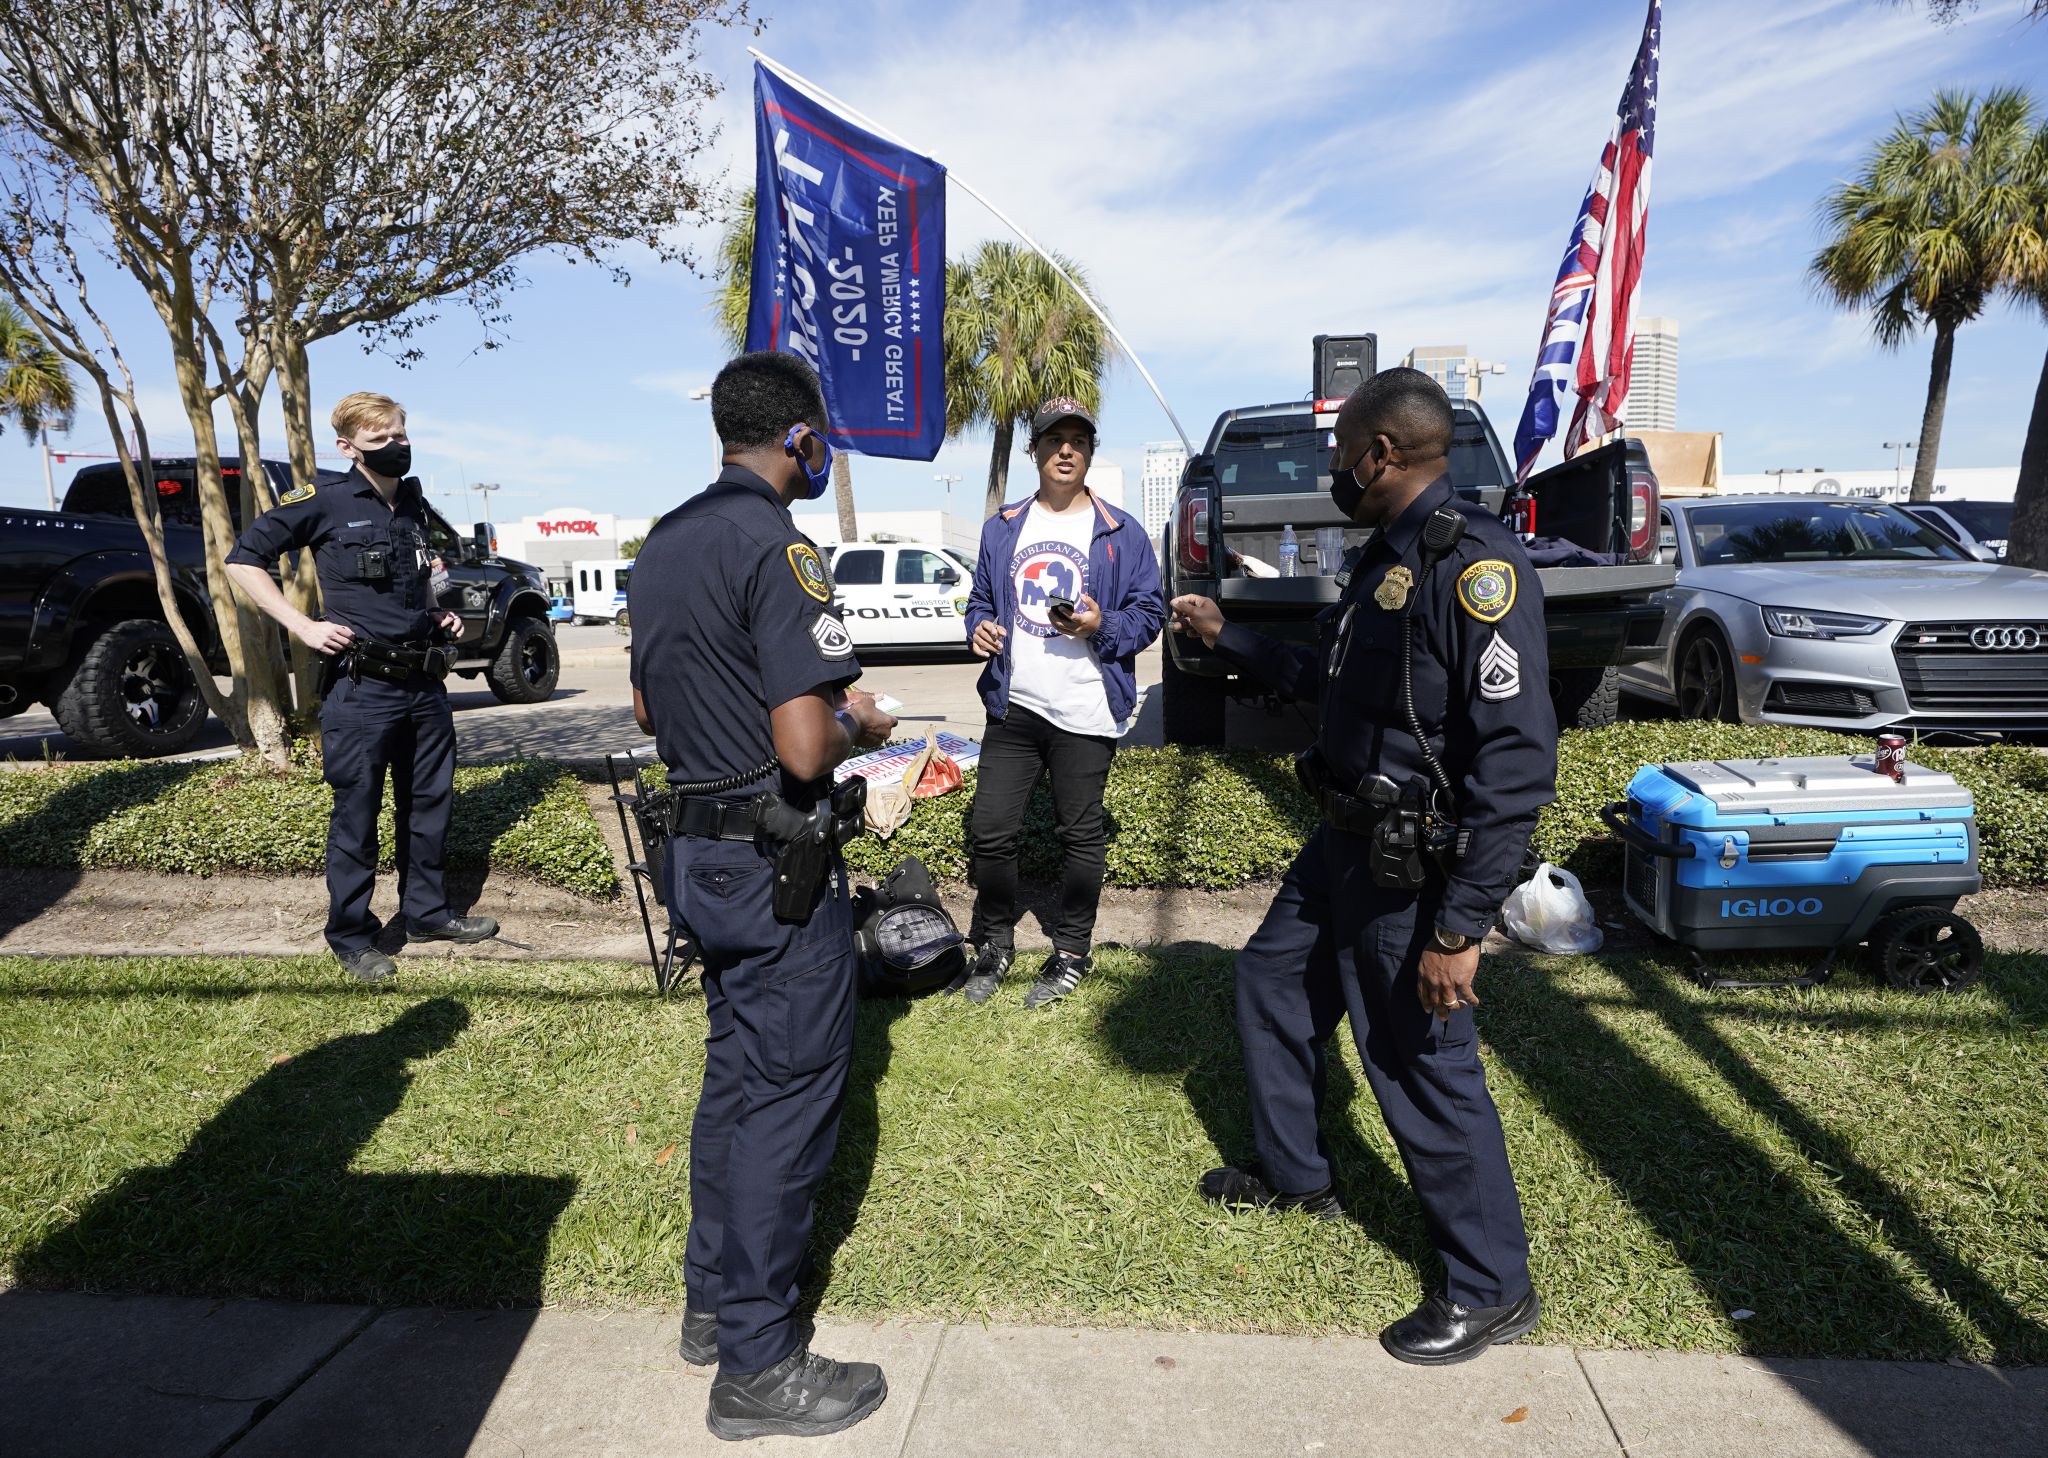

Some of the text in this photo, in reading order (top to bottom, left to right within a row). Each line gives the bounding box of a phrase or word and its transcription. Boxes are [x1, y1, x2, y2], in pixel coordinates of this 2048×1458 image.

[1846, 486, 1909, 497] ATHLETC
[1010, 542, 1072, 578] REPUBLICAN
[1463, 564, 1506, 582] HOUSTON
[1477, 599, 1506, 611] POLICE
[1015, 614, 1028, 628] OF
[1721, 898, 1823, 918] IGLOO
